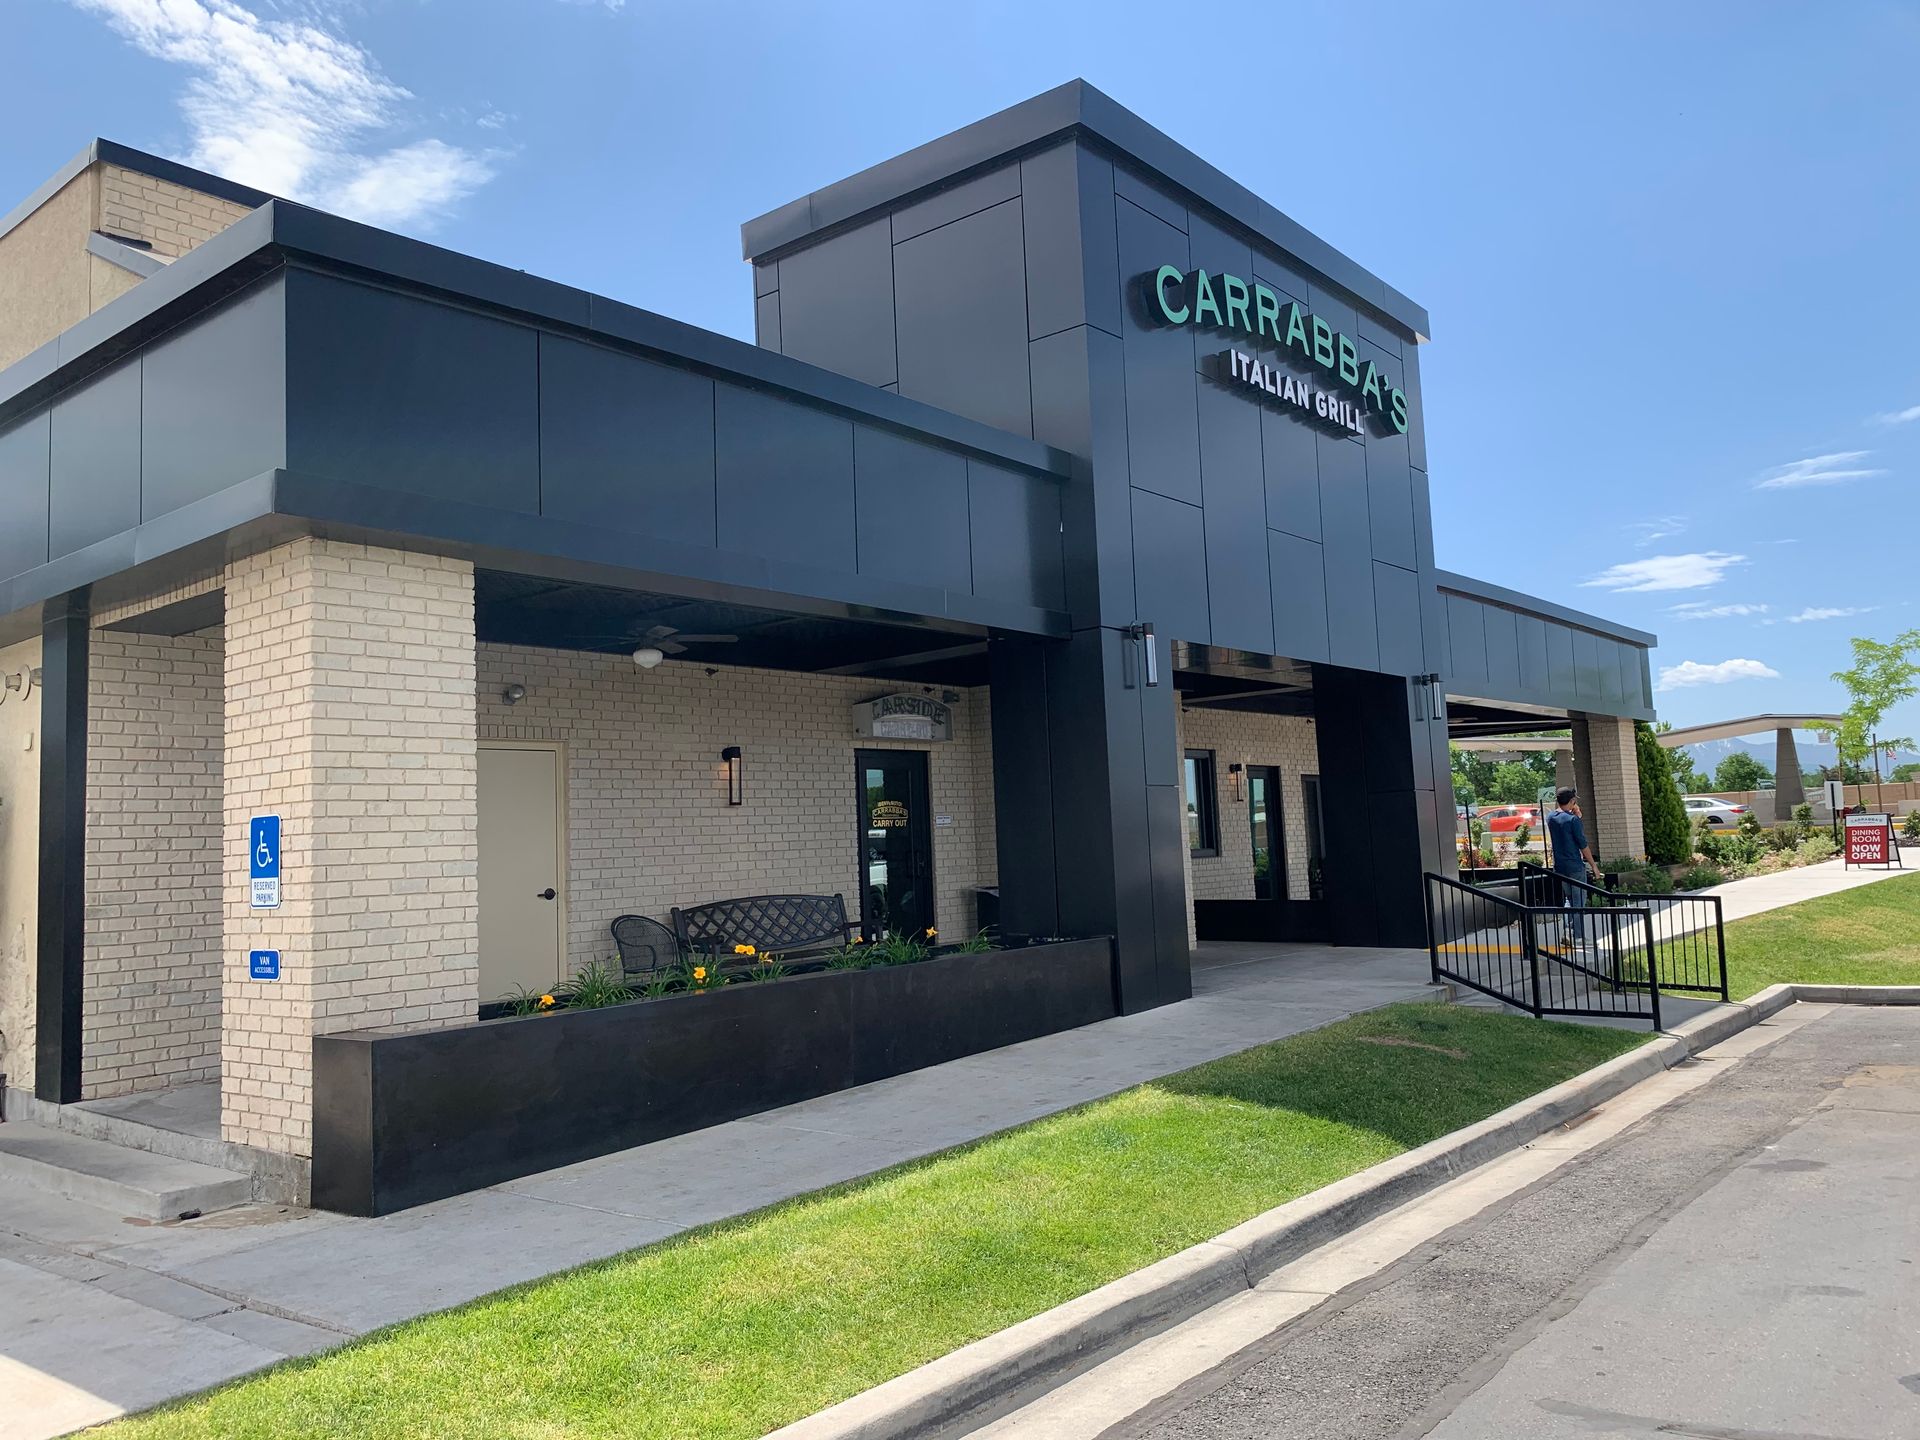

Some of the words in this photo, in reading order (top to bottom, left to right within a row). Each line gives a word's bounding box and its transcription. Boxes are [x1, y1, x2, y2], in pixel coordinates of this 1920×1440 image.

[1156, 264, 1409, 434] CARRABBA'S
[1230, 349, 1310, 410] ITALIAN
[1315, 391, 1365, 435] GRILL
[872, 819, 894, 828] CARRY
[895, 819, 908, 827] OUT
[1851, 835, 1881, 843] ROOM
[1851, 844, 1881, 853] NOW
[1851, 852, 1881, 860] OPEN
[253, 881, 276, 891] RESERVED
[255, 893, 274, 902] PARKING
[259, 956, 270, 965] VAN
